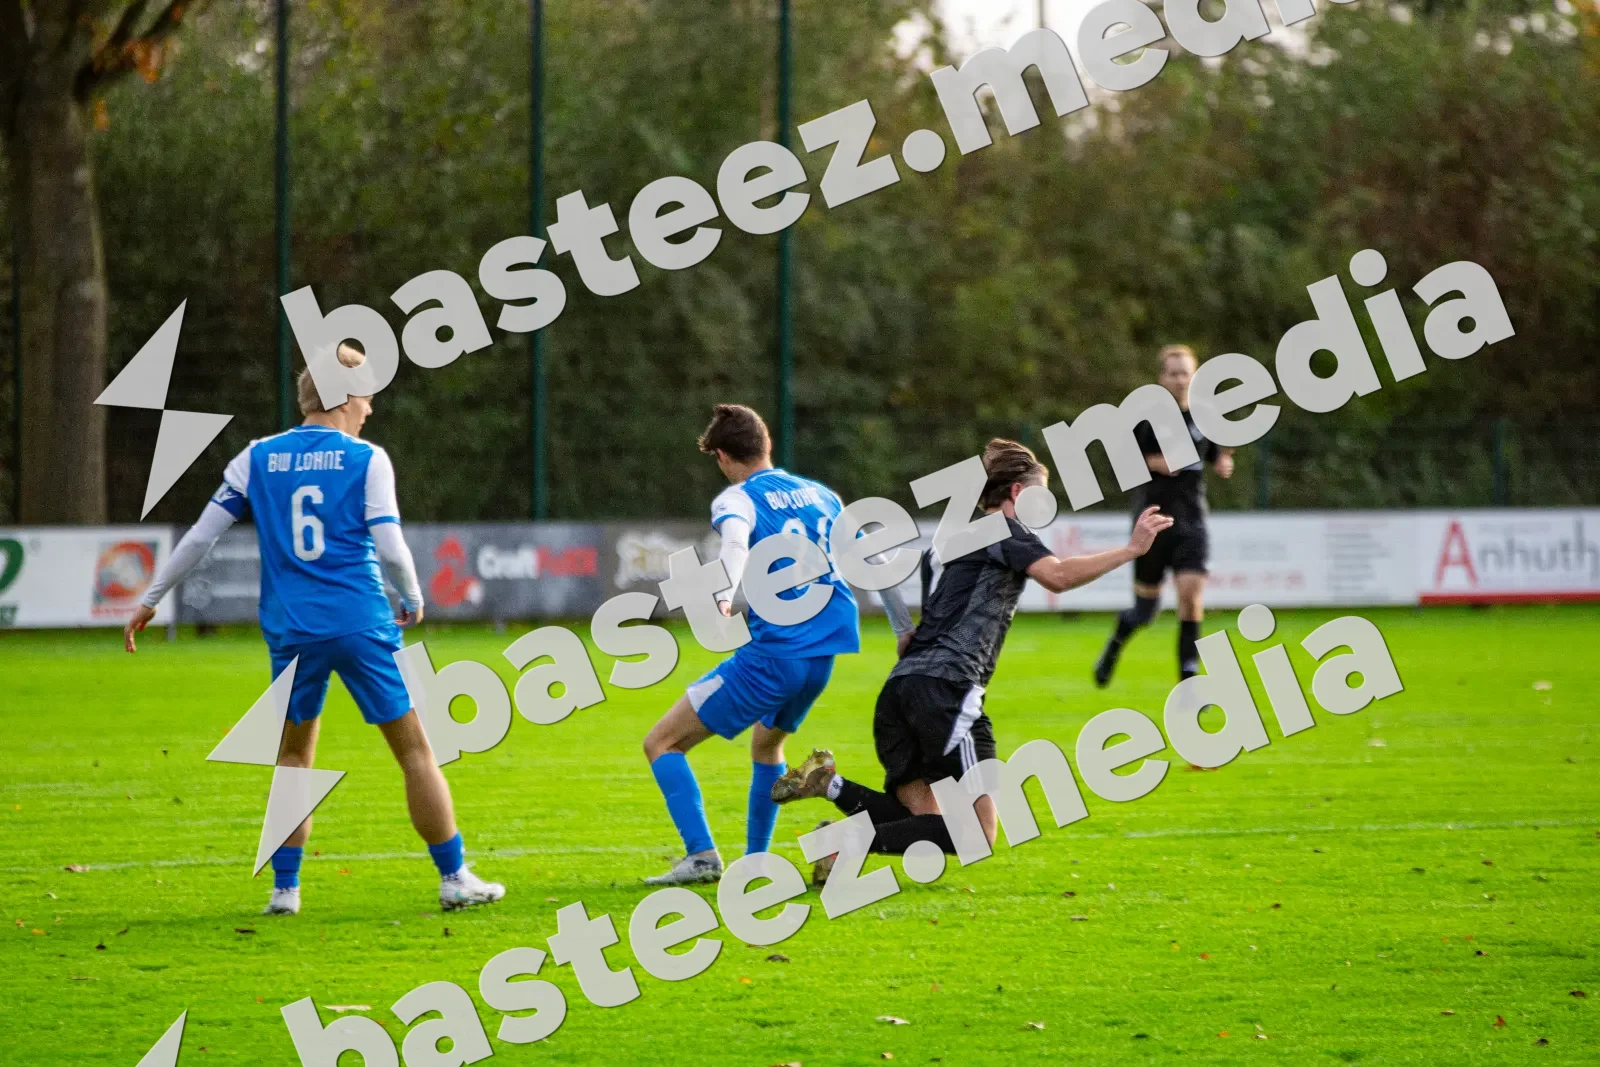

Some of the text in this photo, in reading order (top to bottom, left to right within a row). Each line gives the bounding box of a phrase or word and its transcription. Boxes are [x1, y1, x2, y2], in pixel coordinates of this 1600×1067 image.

[268, 450, 345, 472] BW LOHNE
[292, 485, 325, 561] 6
